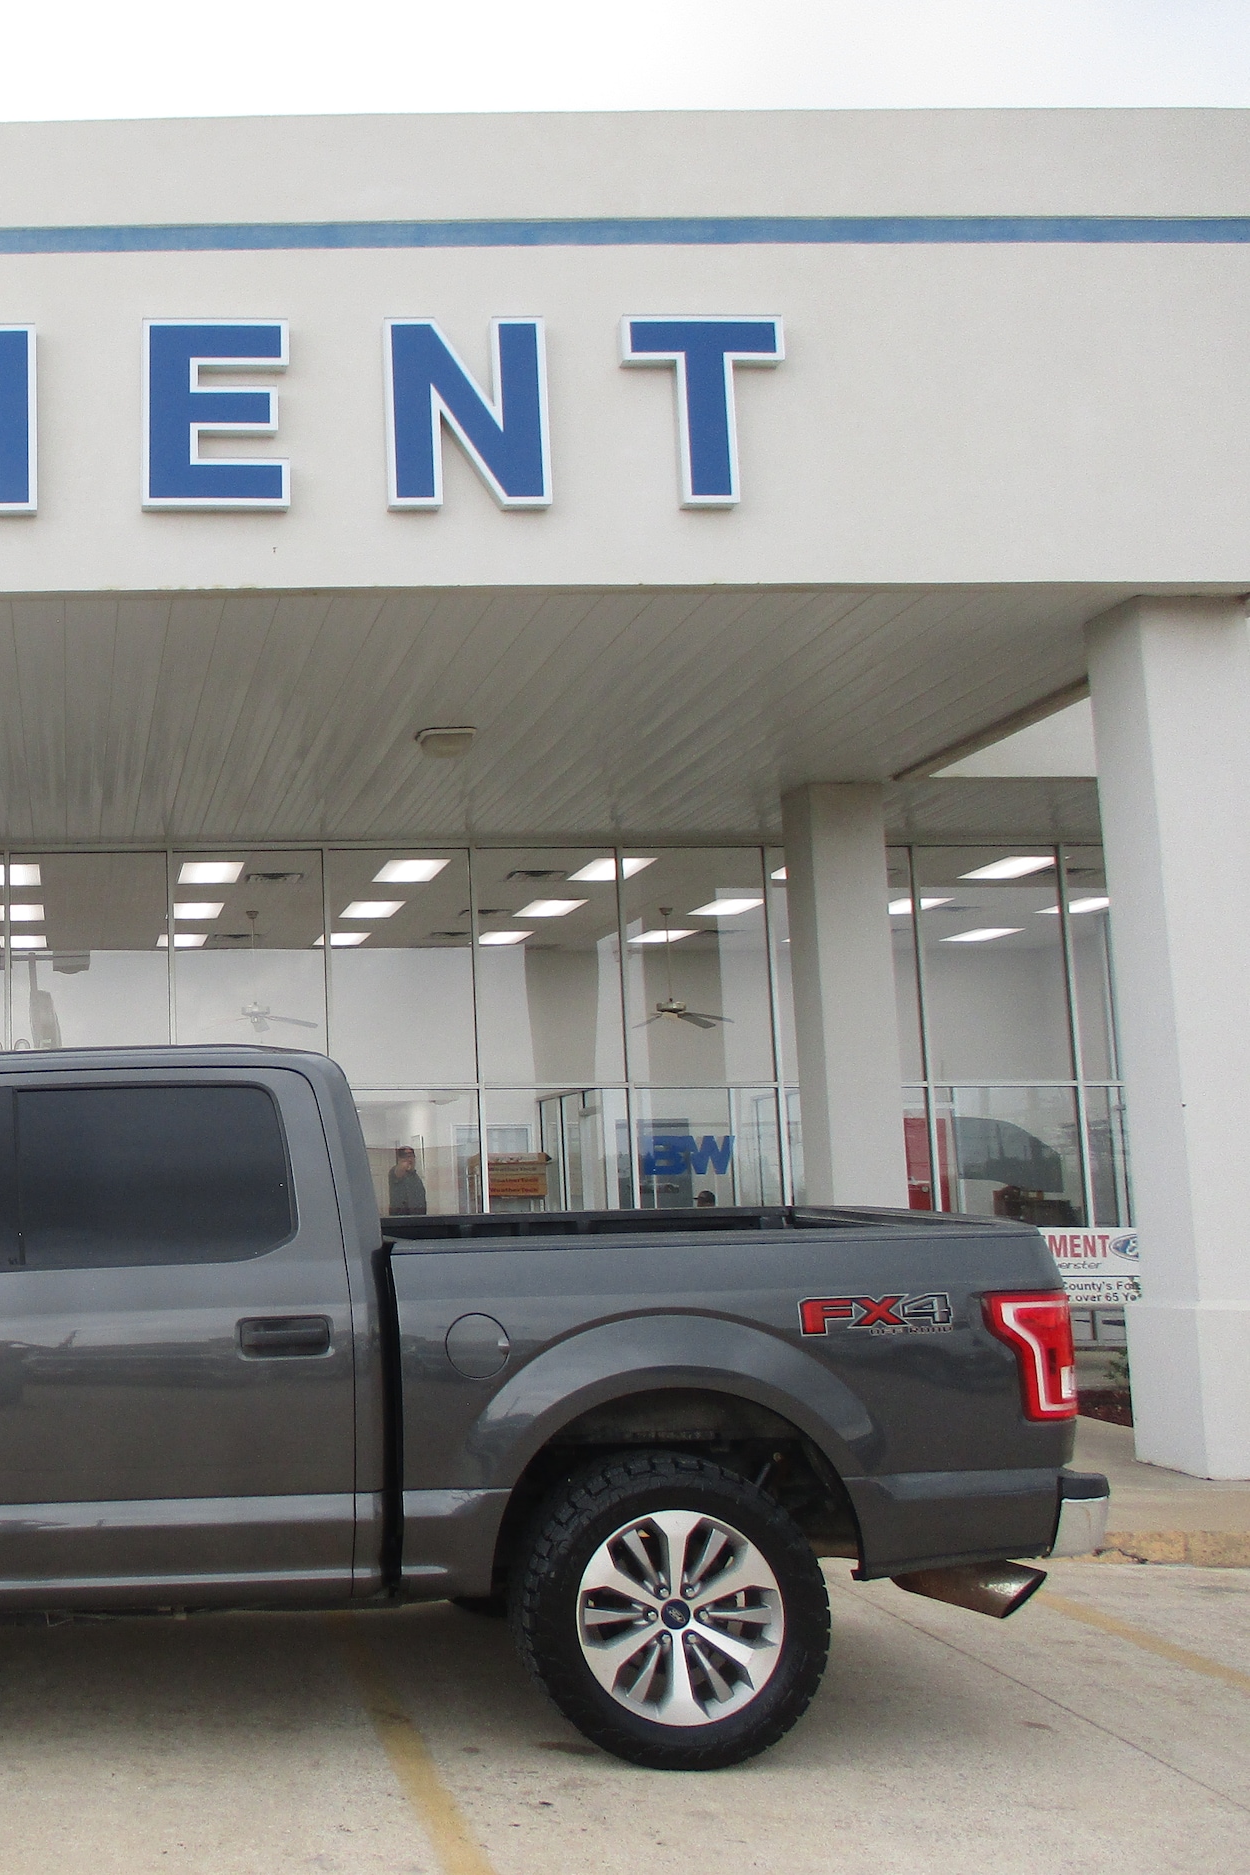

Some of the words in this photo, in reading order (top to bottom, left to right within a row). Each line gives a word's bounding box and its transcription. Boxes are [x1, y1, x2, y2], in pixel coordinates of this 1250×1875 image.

[1043, 1235, 1109, 1258] MENT
[1075, 1294, 1102, 1302] over
[1105, 1292, 1119, 1302] 65
[798, 1292, 953, 1337] FX4
